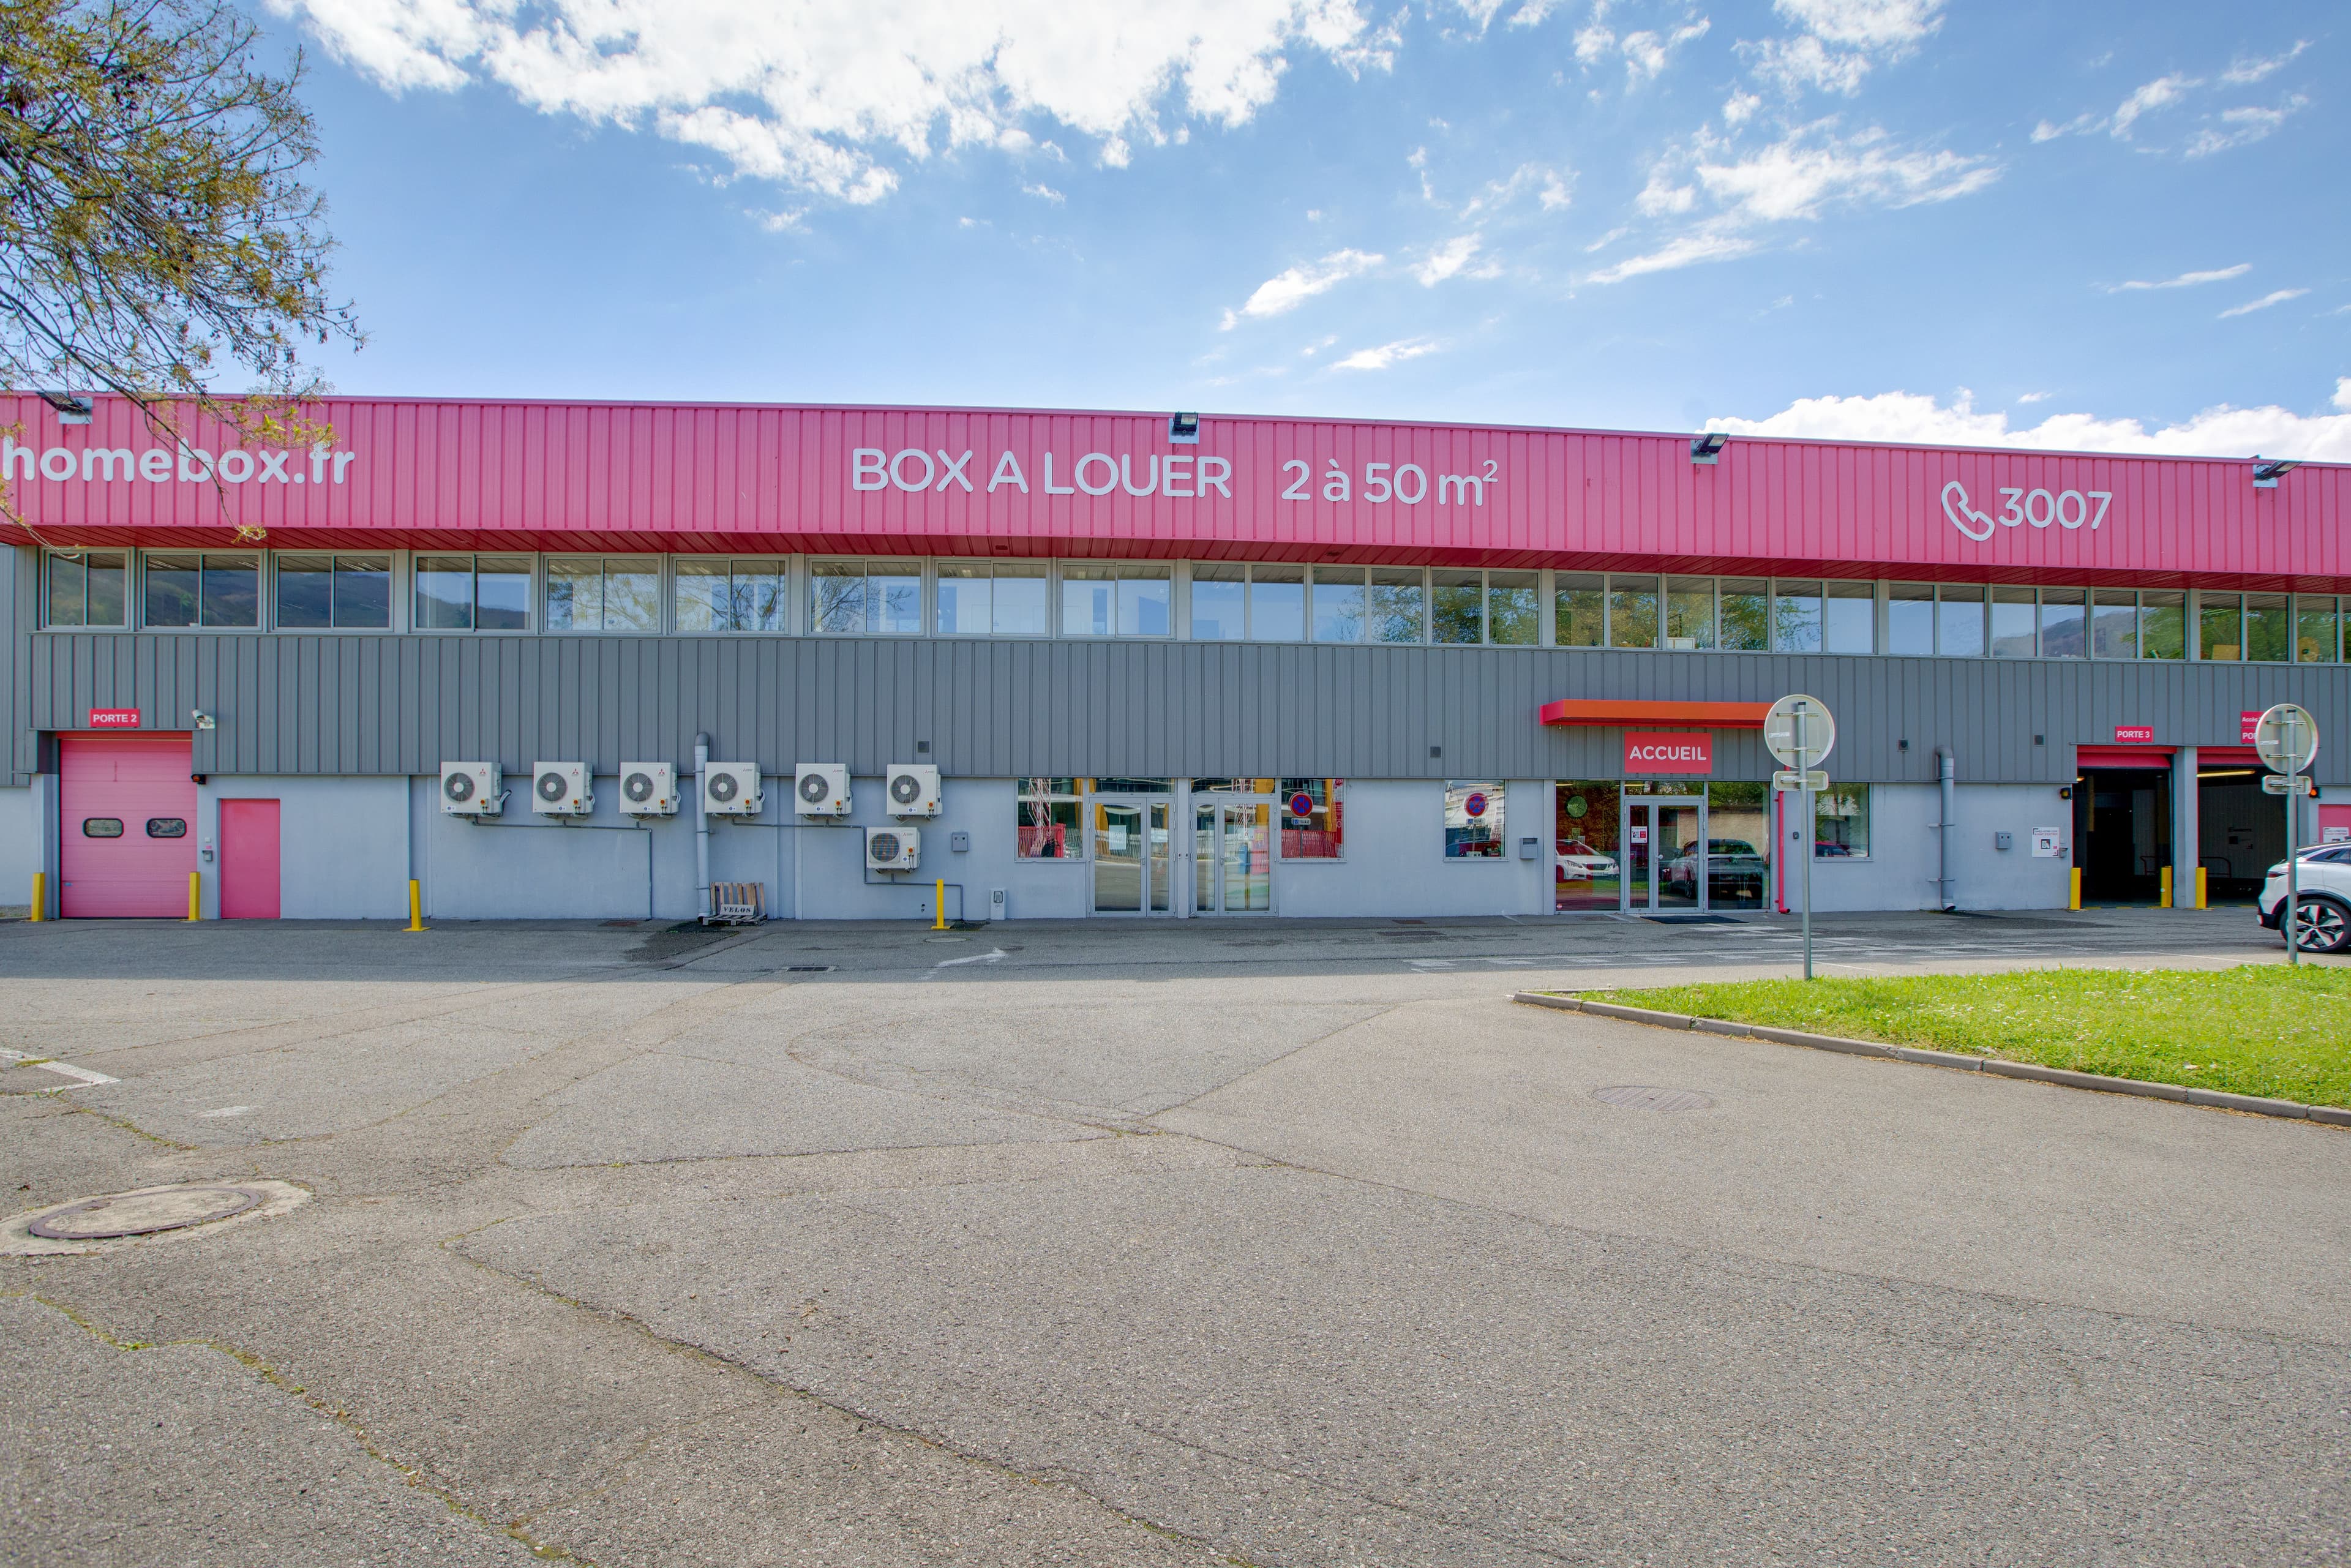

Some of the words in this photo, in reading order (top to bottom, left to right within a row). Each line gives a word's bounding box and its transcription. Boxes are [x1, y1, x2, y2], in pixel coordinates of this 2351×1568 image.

[2, 435, 356, 484] homebox.fr
[852, 448, 973, 492] BOX
[987, 450, 1029, 493] A
[1044, 452, 1232, 498] LOUER
[1281, 459, 1311, 500] 2
[1323, 459, 1351, 502] à
[1363, 462, 1428, 505] 50
[1998, 487, 2113, 530] 3007
[93, 714, 129, 723] PORTE
[130, 714, 137, 723] 2
[1629, 746, 1707, 760] ACCUEIL
